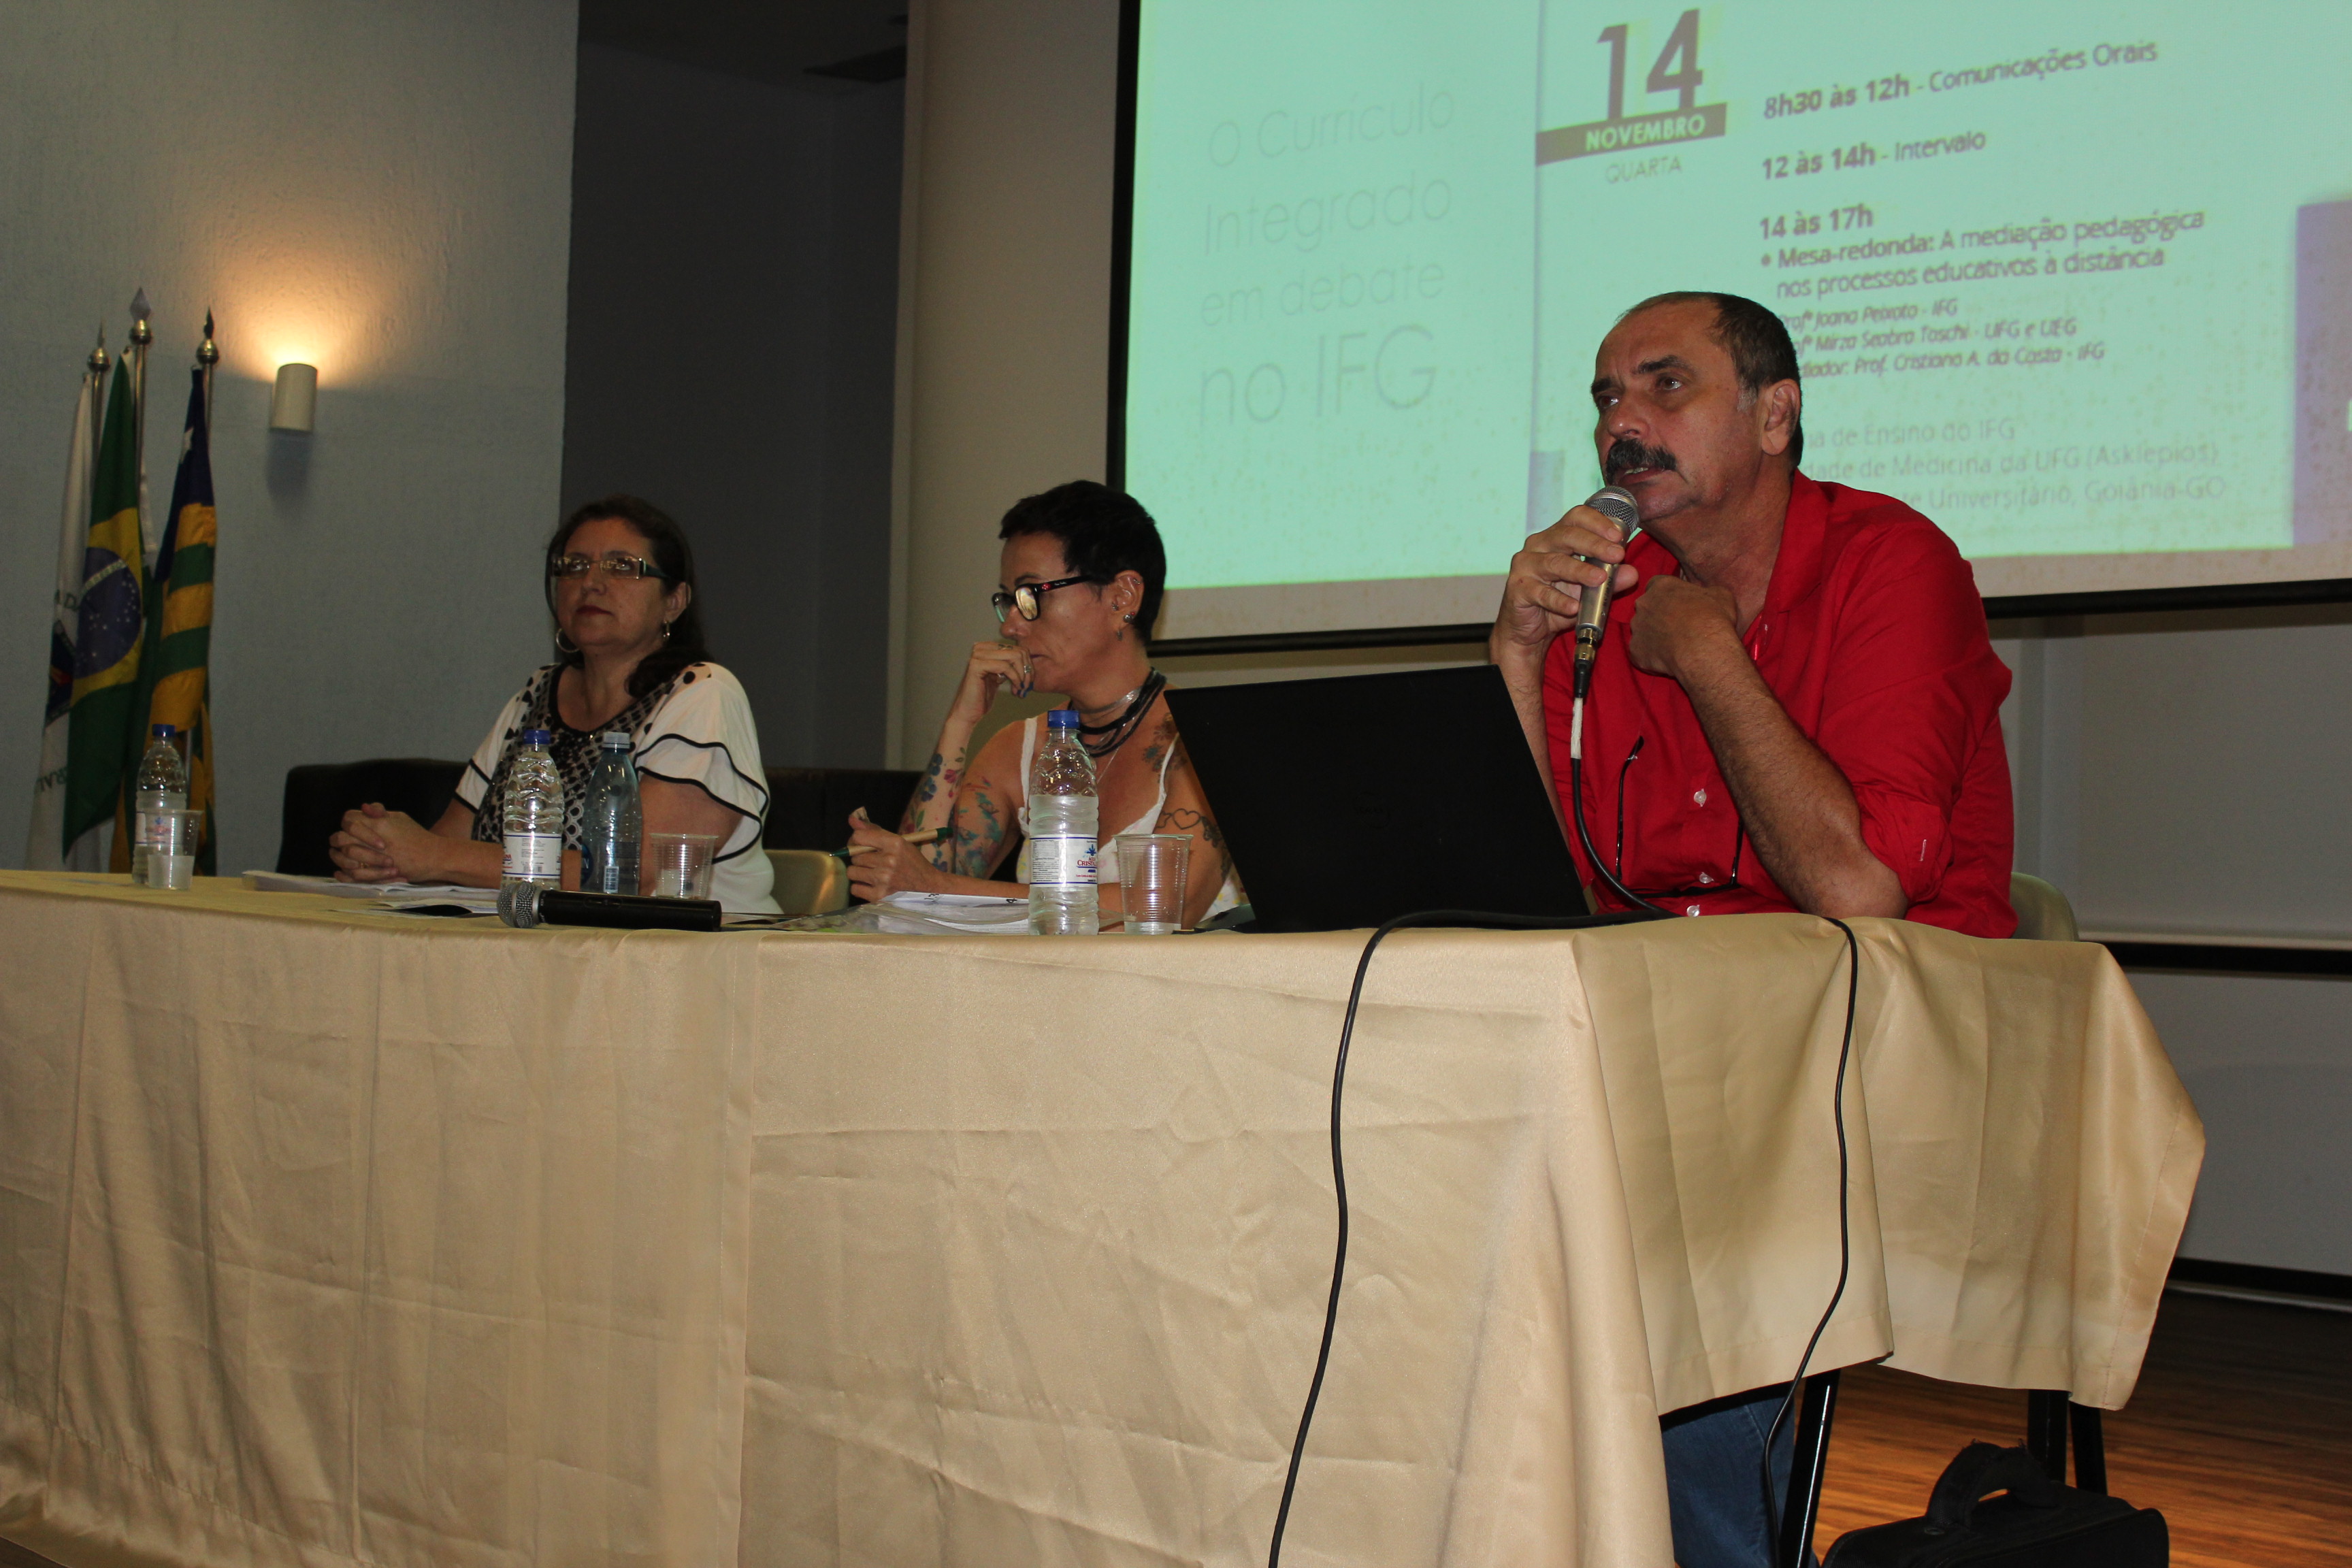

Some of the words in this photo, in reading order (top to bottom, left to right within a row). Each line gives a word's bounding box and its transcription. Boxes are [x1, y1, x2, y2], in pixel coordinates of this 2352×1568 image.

[1597, 8, 1703, 120] 14
[1763, 90, 1823, 119] 8h30
[1830, 84, 1857, 109] às
[1865, 73, 1910, 103] 12h
[1929, 48, 2087, 92] Comunicações
[2093, 39, 2158, 67] Orais
[1259, 82, 1454, 158] Currículo
[1585, 114, 1706, 152] NOVEMBRO
[1605, 156, 1682, 184] QUARTA
[1762, 156, 1788, 180] 12
[1795, 150, 1823, 175] às
[1831, 142, 1876, 171] 14h
[1895, 131, 1987, 162] Intervalo
[1205, 172, 1452, 255] Integrado
[1761, 215, 1786, 240] 14
[1793, 210, 1821, 236] às
[1830, 203, 1874, 231] 17h
[1778, 233, 1935, 269] Mesa-redonda:
[1940, 229, 1955, 250] A
[1961, 217, 2067, 250] mediação
[2074, 208, 2205, 248] pedagógica
[1202, 286, 1262, 326] em
[1279, 256, 1446, 316] debate
[1777, 279, 1812, 299] nos
[1818, 269, 1918, 300] processos
[1923, 256, 2038, 284] educativos
[2045, 250, 2057, 274] à
[2063, 246, 2165, 273] distância
[1931, 298, 1957, 316] IFG
[1984, 319, 2020, 339] UFG
[2040, 317, 2078, 338] UEG
[1200, 363, 1286, 426] no
[1318, 324, 1439, 417] IFG
[2077, 341, 2105, 361] IFG
[1864, 425, 1935, 445] Ensino
[1980, 417, 2016, 440] IFG
[1893, 453, 1991, 476] Medicina
[2036, 446, 2078, 471] UFG
